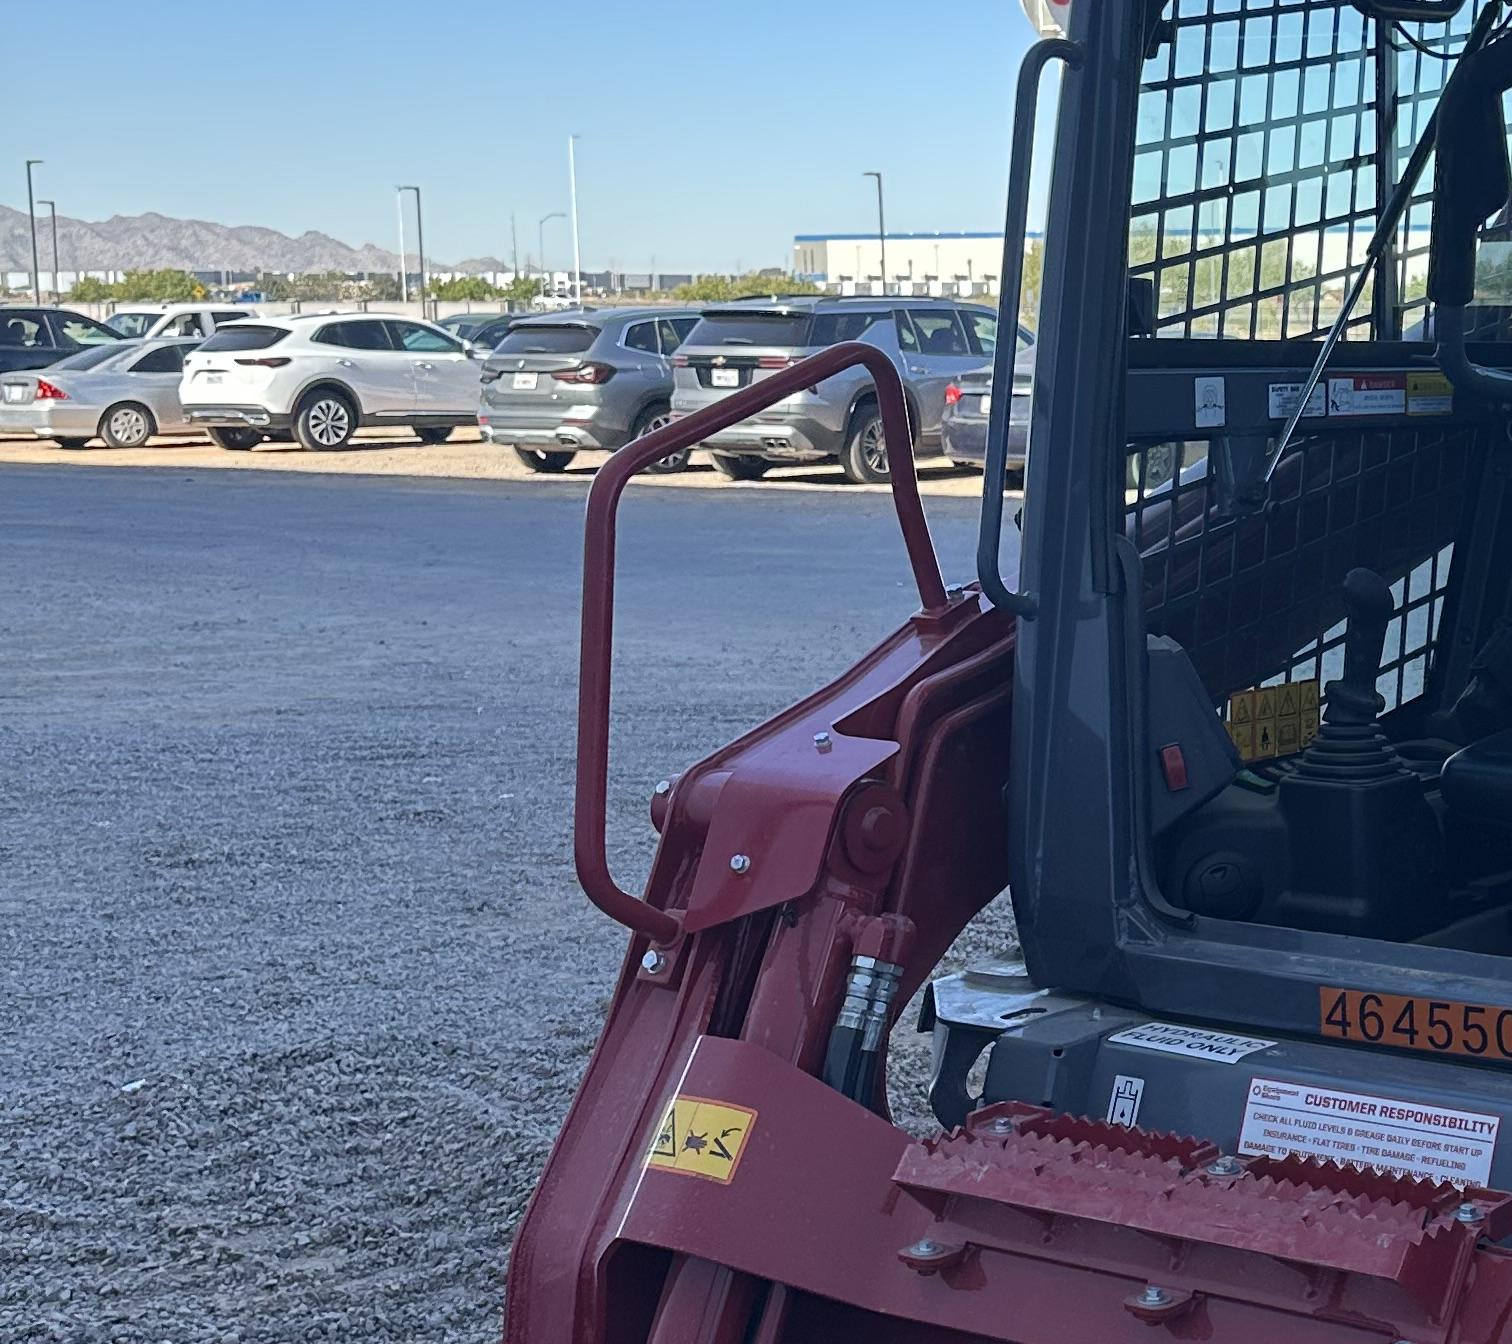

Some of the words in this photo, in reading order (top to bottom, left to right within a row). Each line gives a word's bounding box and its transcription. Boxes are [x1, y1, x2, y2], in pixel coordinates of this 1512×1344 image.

[1121, 1031, 1181, 1046] FLUID
[1185, 1042, 1243, 1056] ONLY
[1142, 1024, 1267, 1050] HYDRAULIC
[1304, 1093, 1377, 1117] CUSTOMER
[1379, 1105, 1496, 1135] RESPONSIBILITY
[1244, 1141, 1275, 1154] DAMAGE
[1277, 1147, 1287, 1155] TO
[1253, 1112, 1278, 1123] CHECK
[1279, 1117, 1292, 1126] ALL
[1294, 1119, 1318, 1129] FLUID
[1318, 1123, 1346, 1135] LEVELS
[1386, 1134, 1410, 1145] DAILY
[1411, 1138, 1443, 1151] BEFORE
[1443, 1143, 1470, 1155] START
[1471, 1149, 1483, 1157] UP
[1263, 1129, 1307, 1143] INSURANCE
[1312, 1137, 1331, 1147] FLAT
[1361, 1145, 1380, 1156] TIRE
[1381, 1149, 1415, 1162] DAMAGE
[1421, 1156, 1466, 1171] REFUELING
